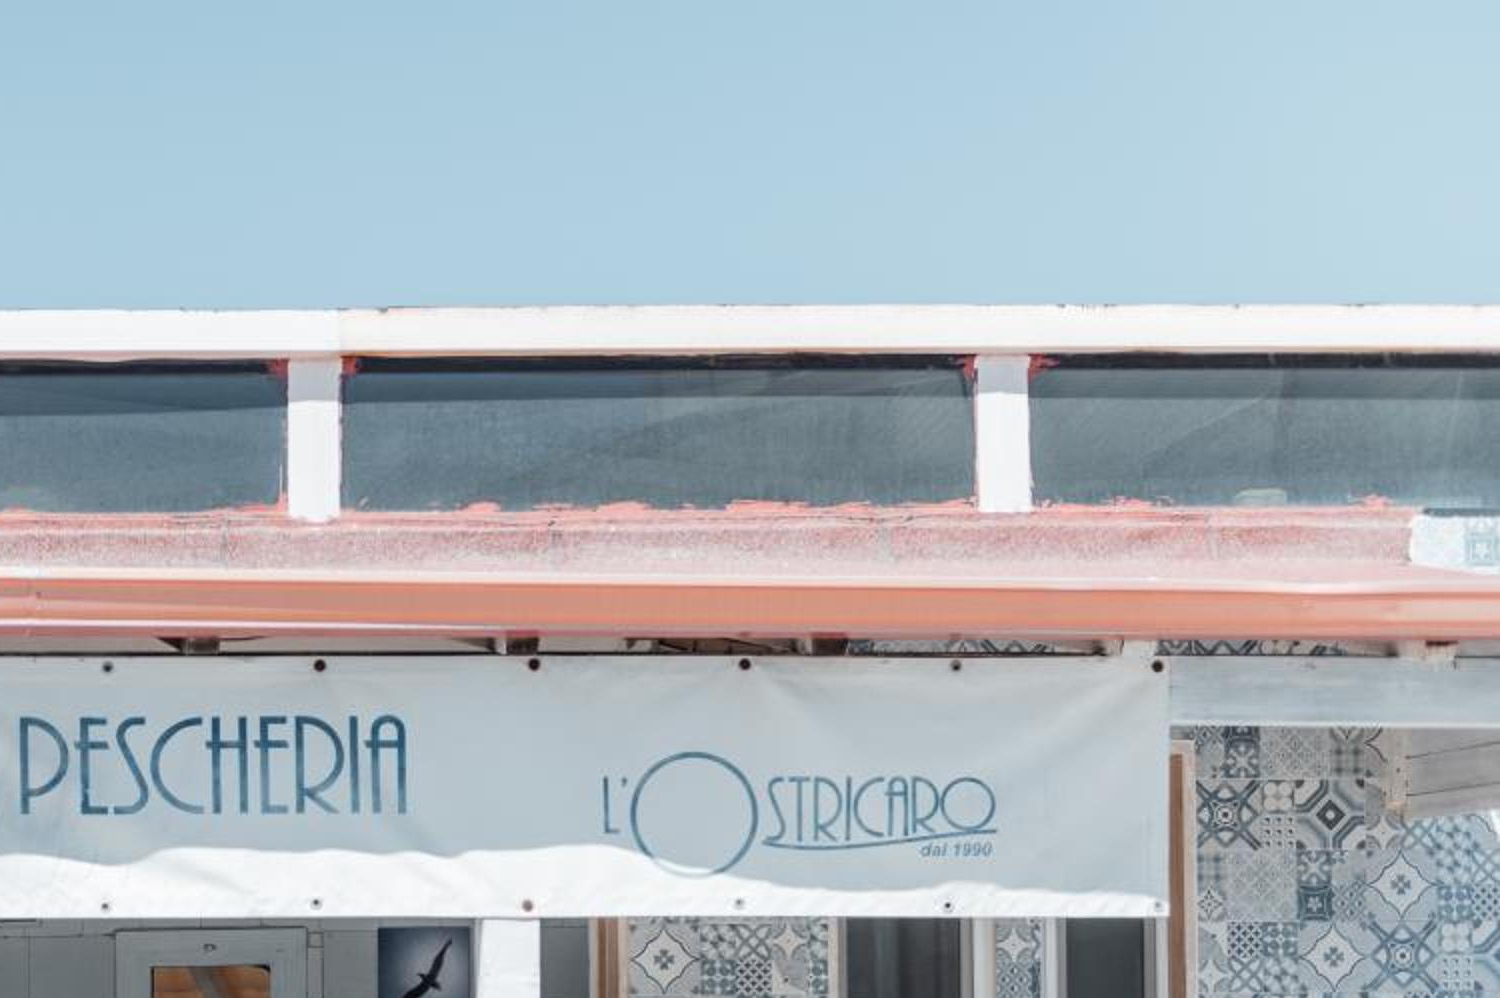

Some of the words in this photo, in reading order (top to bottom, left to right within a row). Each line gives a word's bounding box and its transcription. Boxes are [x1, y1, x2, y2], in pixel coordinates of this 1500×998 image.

[19, 715, 407, 815] PESCHERIA
[920, 843, 948, 857] dal
[953, 841, 993, 857] 1990
